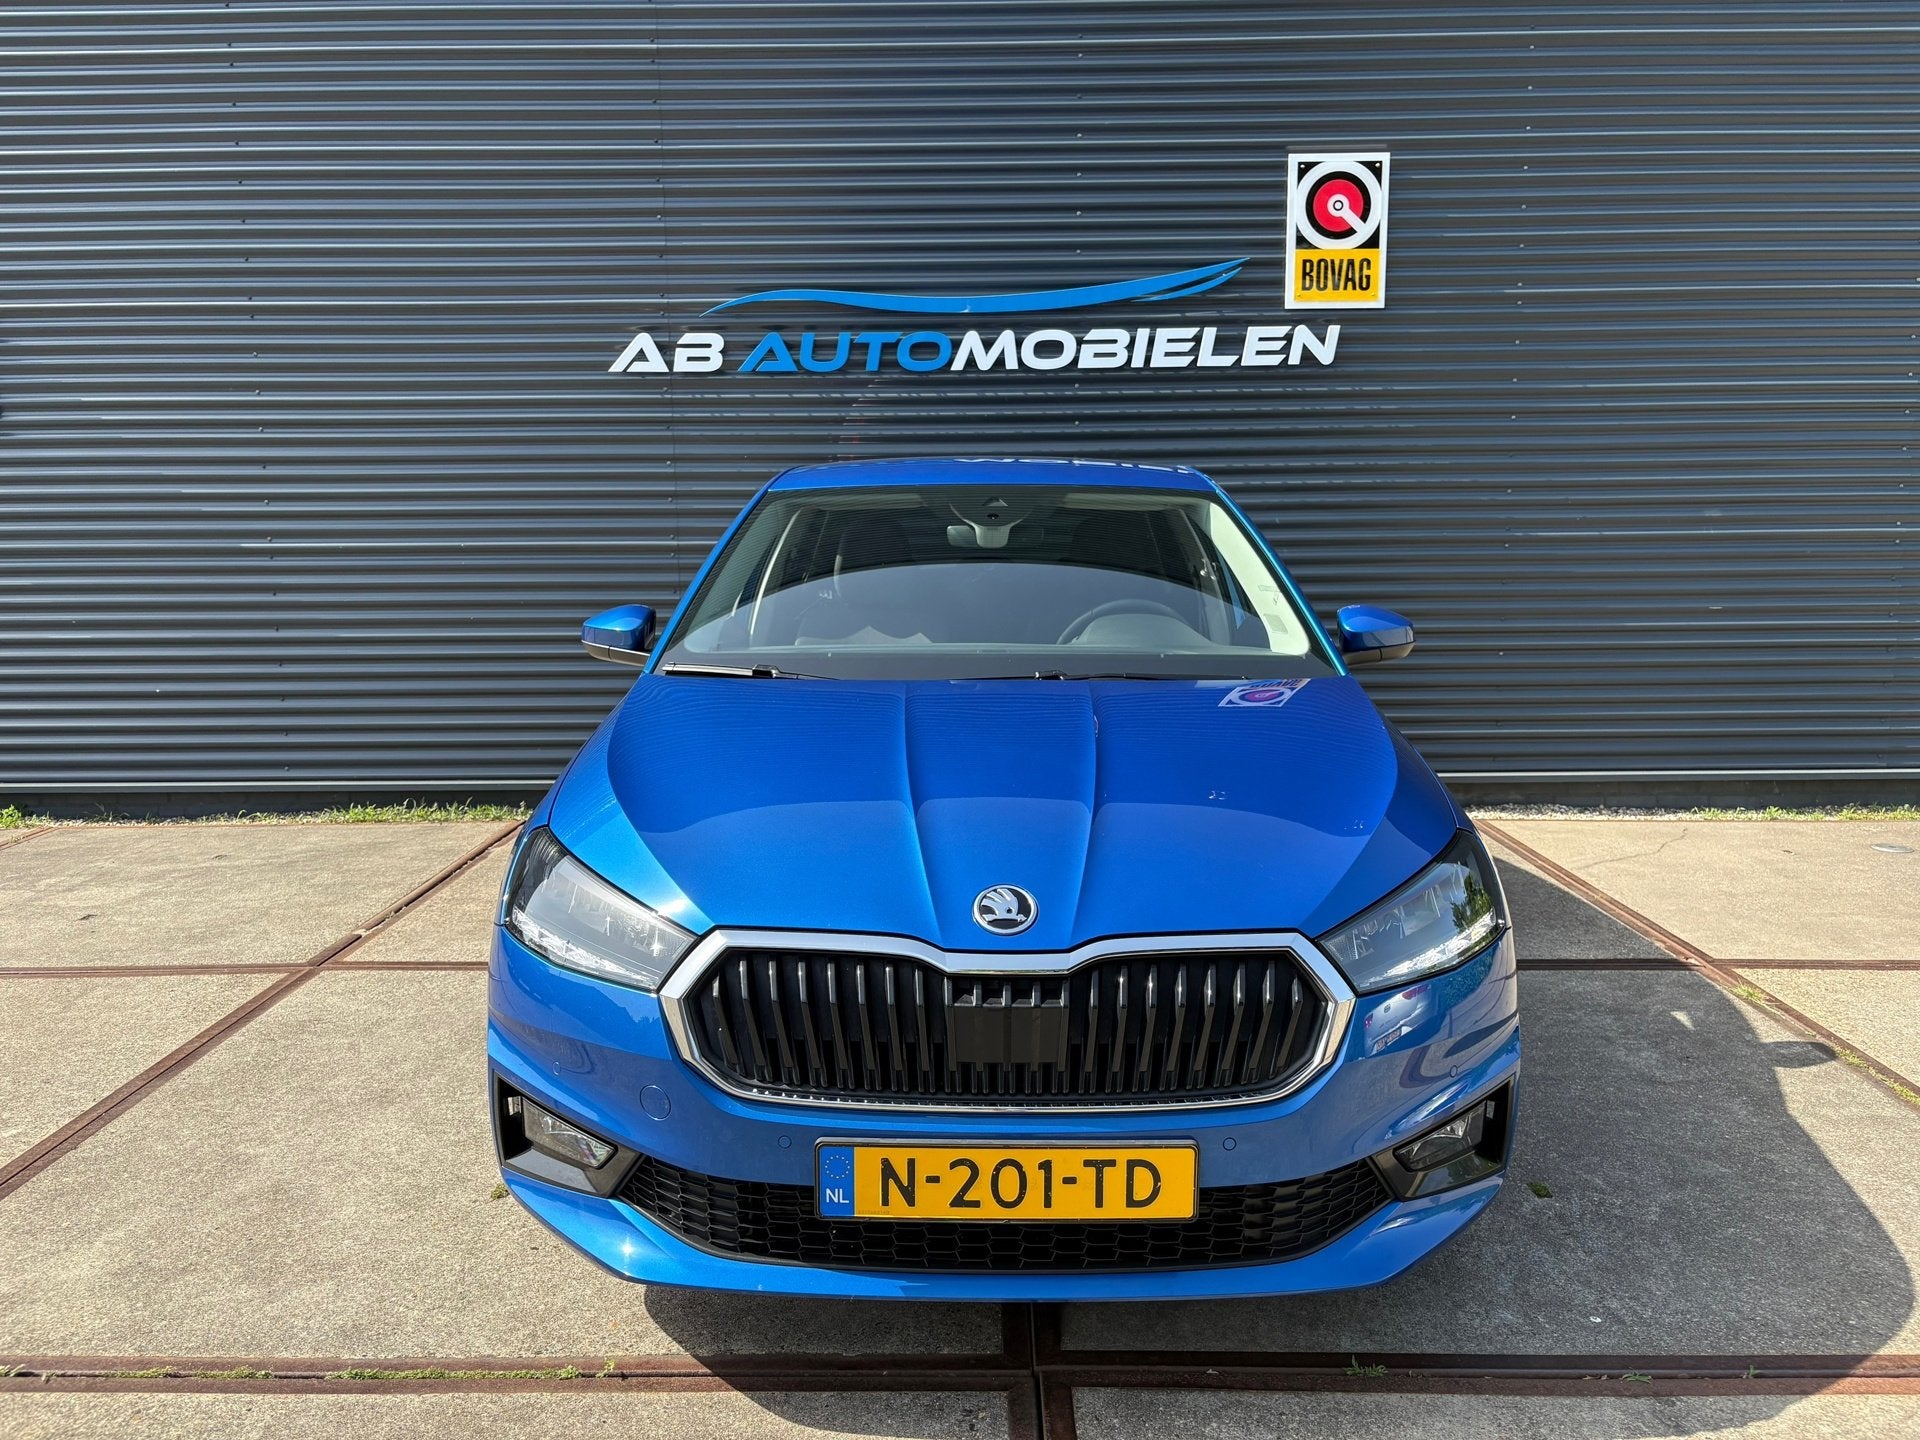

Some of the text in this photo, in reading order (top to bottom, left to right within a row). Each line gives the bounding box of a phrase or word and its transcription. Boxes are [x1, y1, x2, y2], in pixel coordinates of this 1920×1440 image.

[1301, 258, 1372, 291] BOVAG
[607, 324, 1341, 373] AB AUTOMOBIELEN
[825, 1188, 850, 1204] NL
[880, 1157, 1162, 1208] N-201-TD
